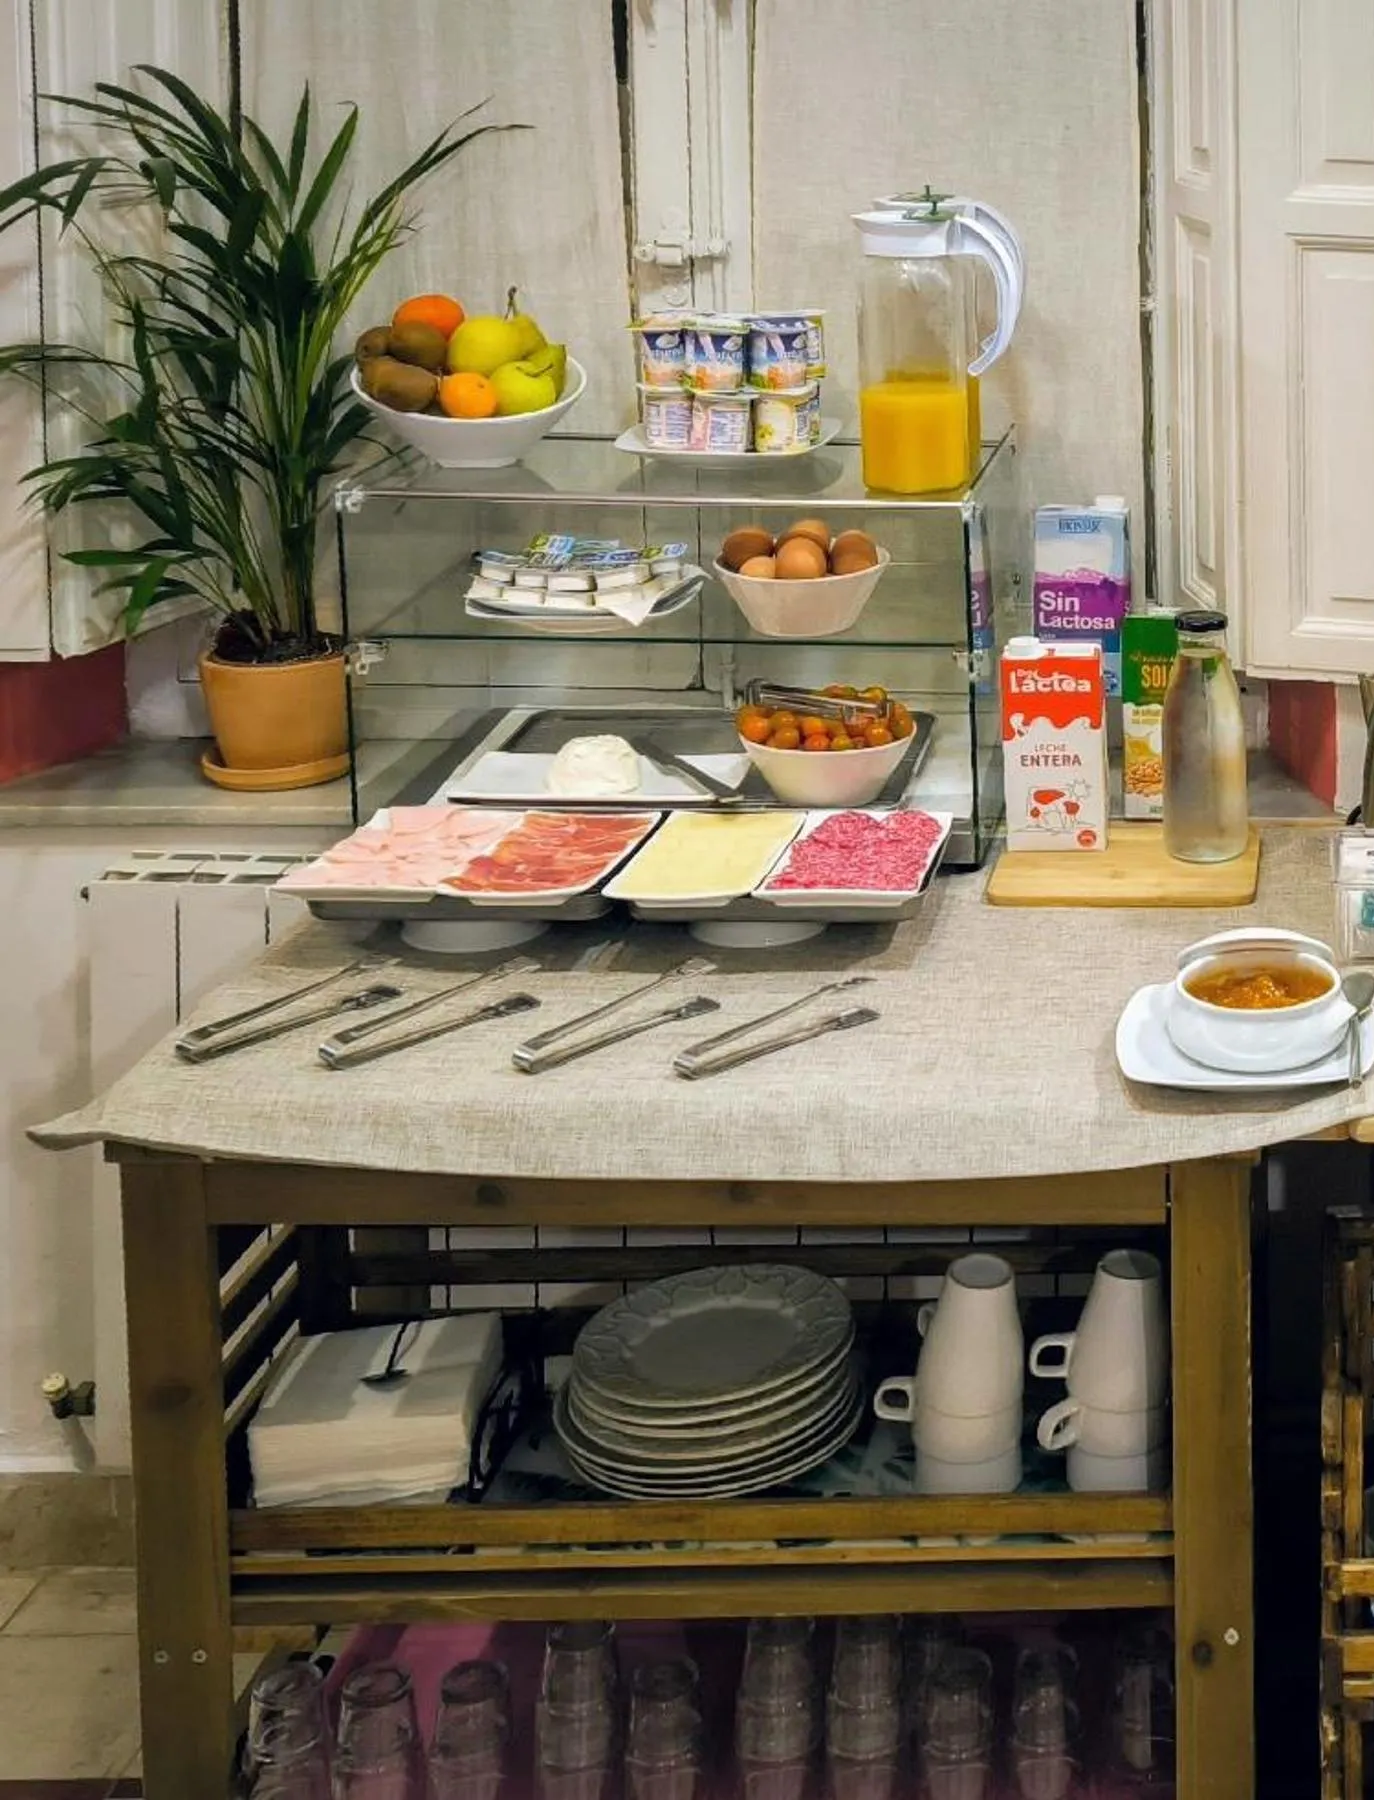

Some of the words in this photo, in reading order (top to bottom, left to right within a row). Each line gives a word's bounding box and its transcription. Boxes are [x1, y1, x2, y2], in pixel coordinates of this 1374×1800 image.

[1039, 590, 1080, 612] Sin
[1039, 611, 1116, 630] Lactosa
[1020, 754, 1082, 768] ENTERA
